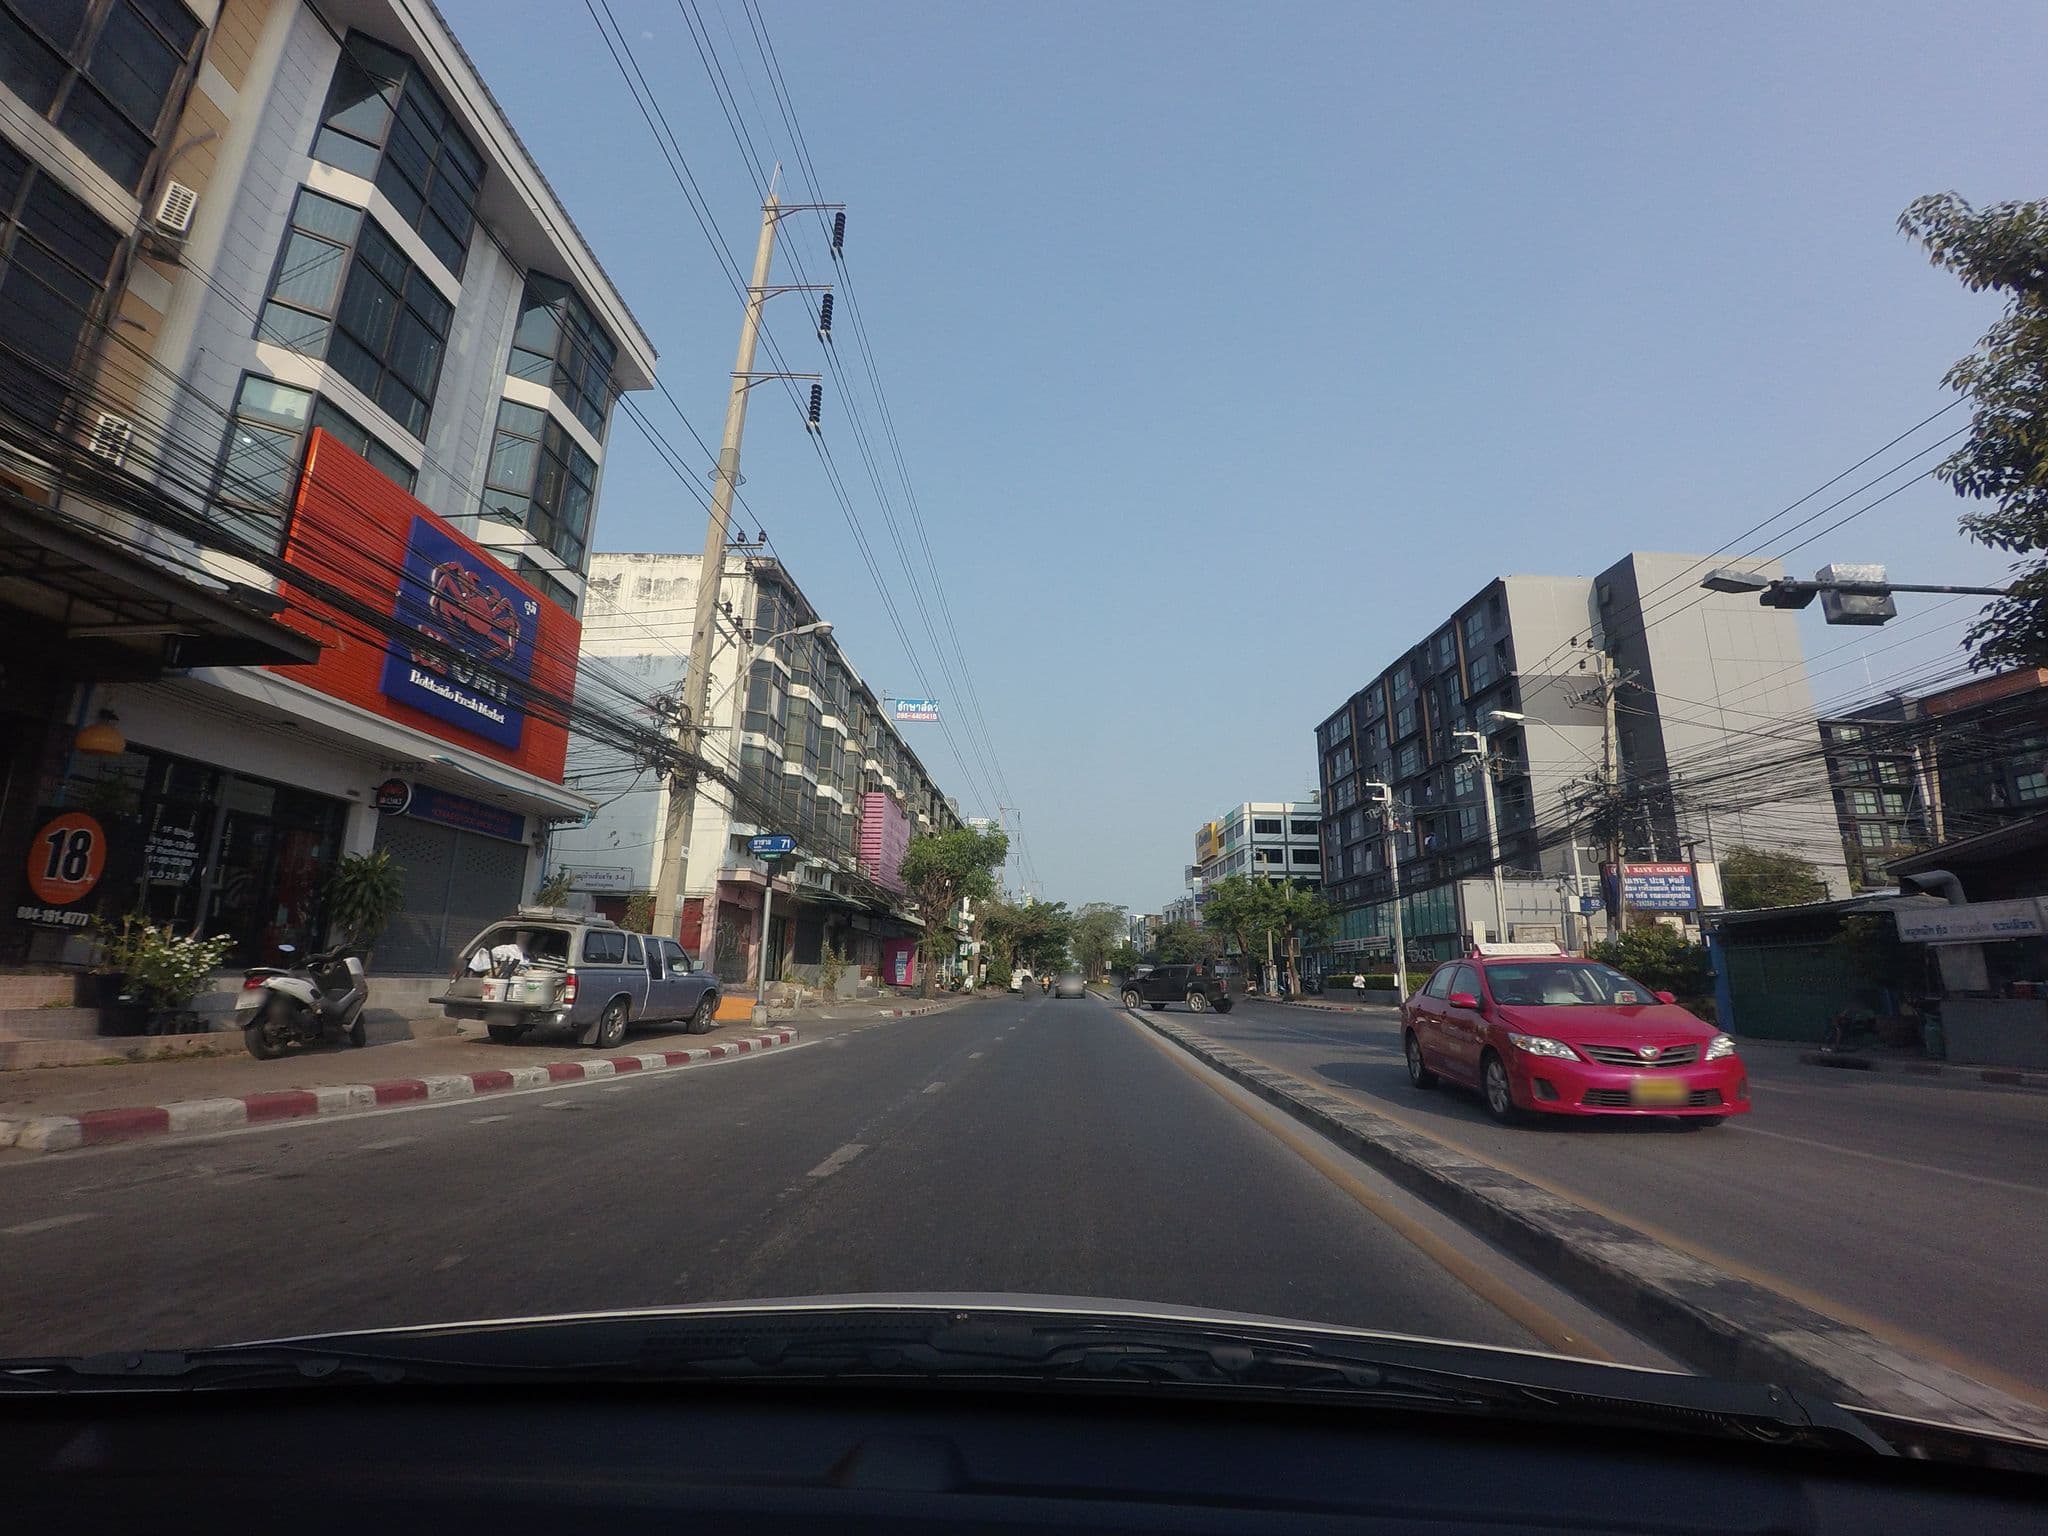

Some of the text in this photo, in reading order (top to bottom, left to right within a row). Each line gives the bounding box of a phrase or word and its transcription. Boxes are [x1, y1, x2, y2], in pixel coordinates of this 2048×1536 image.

[408, 669, 505, 724] Hokkaido Fresh Market
[780, 839, 791, 849] 71
